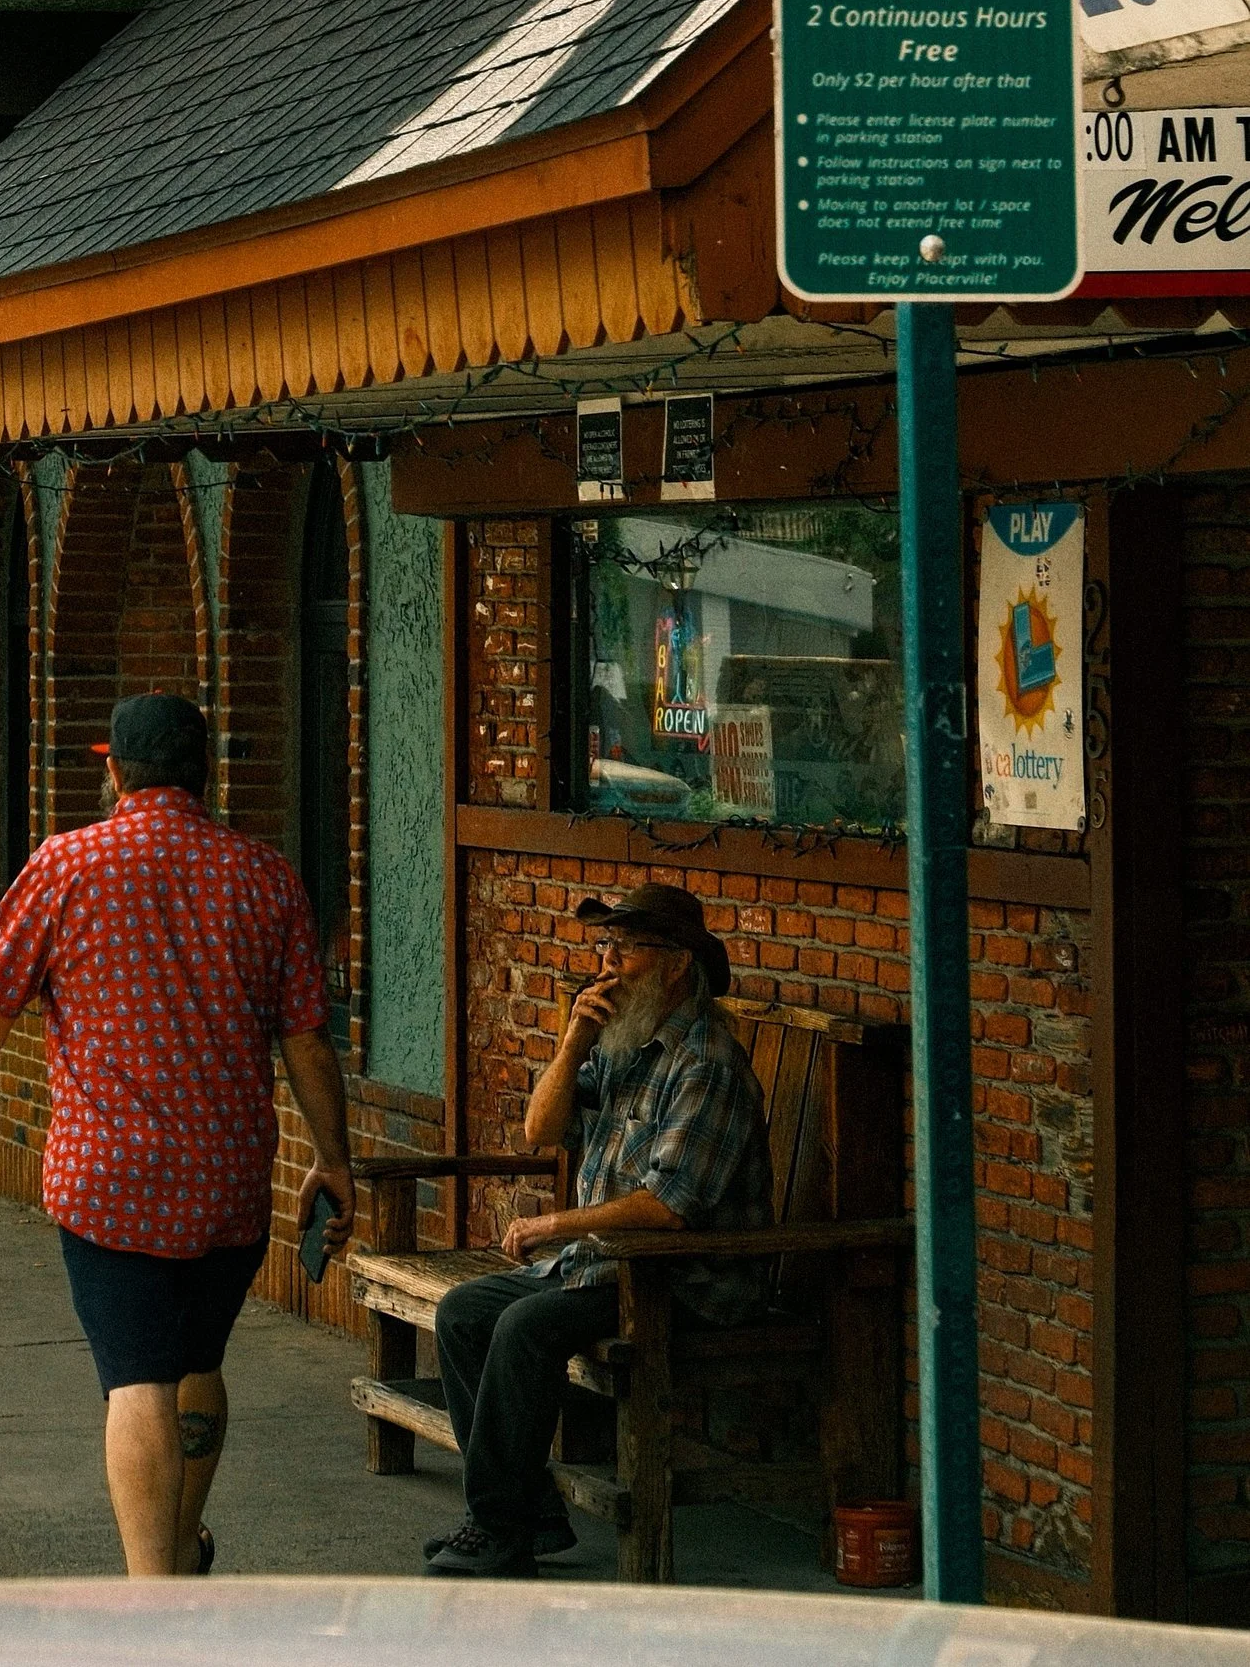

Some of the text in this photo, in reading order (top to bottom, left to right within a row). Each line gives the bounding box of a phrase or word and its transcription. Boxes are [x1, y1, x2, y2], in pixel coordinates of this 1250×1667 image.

[806, 4, 1048, 28] 2 Continuous Hours
[898, 39, 959, 62] Free
[812, 71, 1032, 93] Only $2 per hour after that
[816, 113, 1057, 130] Please enter license plate number
[816, 131, 943, 147] in parking station
[1157, 116, 1218, 163] AM
[816, 155, 1062, 173] Follow instructions on sign next to
[816, 175, 924, 190] parking station
[817, 199, 868, 214] Moving
[873, 200, 888, 212] to
[893, 199, 949, 212] another
[954, 199, 974, 212] lot
[990, 201, 1032, 215] space
[816, 215, 1003, 232] does not extend free time
[817, 252, 867, 266] Please
[872, 252, 910, 269] keep
[973, 252, 1007, 266] with
[1012, 254, 1045, 270] you.
[867, 271, 998, 288] Enjoy Placerville!
[1009, 511, 1054, 544] PLAY
[663, 707, 706, 735] OPEN
[995, 742, 1065, 790] calottery
